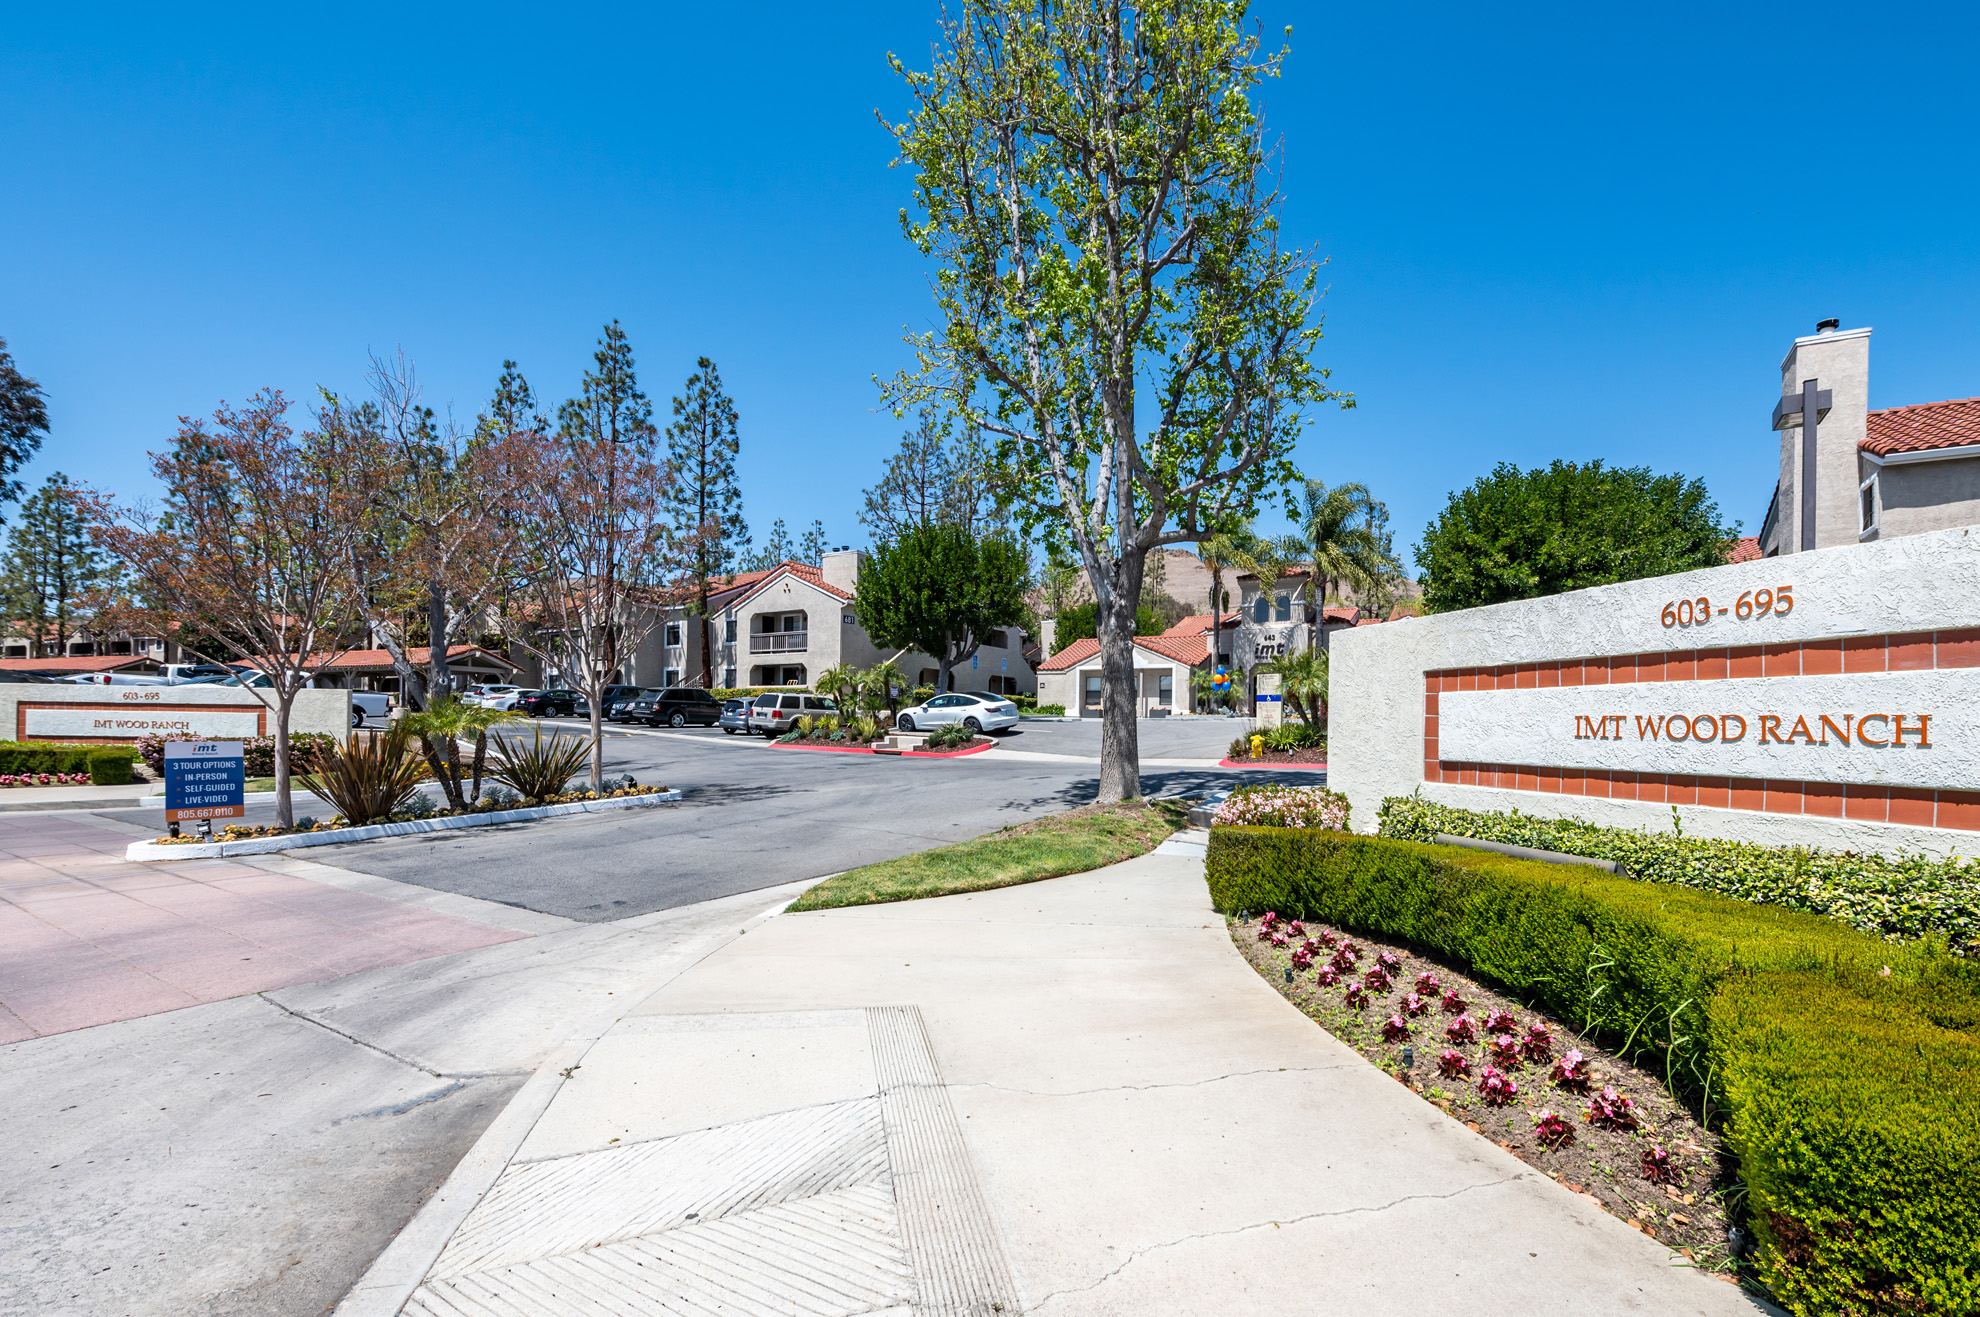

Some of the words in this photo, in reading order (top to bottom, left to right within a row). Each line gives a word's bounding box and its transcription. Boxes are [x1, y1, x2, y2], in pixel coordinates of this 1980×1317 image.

[844, 616, 854, 624] 681
[1254, 642, 1284, 655] imt
[94, 720, 113, 729] IMT
[115, 720, 149, 729] WOOD
[151, 720, 189, 730] RANCH
[1574, 715, 1627, 740] IMT
[1635, 714, 1747, 743] WOOD
[1758, 713, 1933, 747] RANCH
[192, 744, 218, 752] imt
[173, 762, 179, 770] 3
[180, 761, 202, 770] TOUR
[202, 760, 236, 769] OPTIONS
[184, 772, 228, 781] IN-PERSON
[184, 783, 236, 793] SELF-GUIDED
[185, 794, 228, 804] LIVE-VIDEO
[177, 807, 234, 819] 805.667.0110
